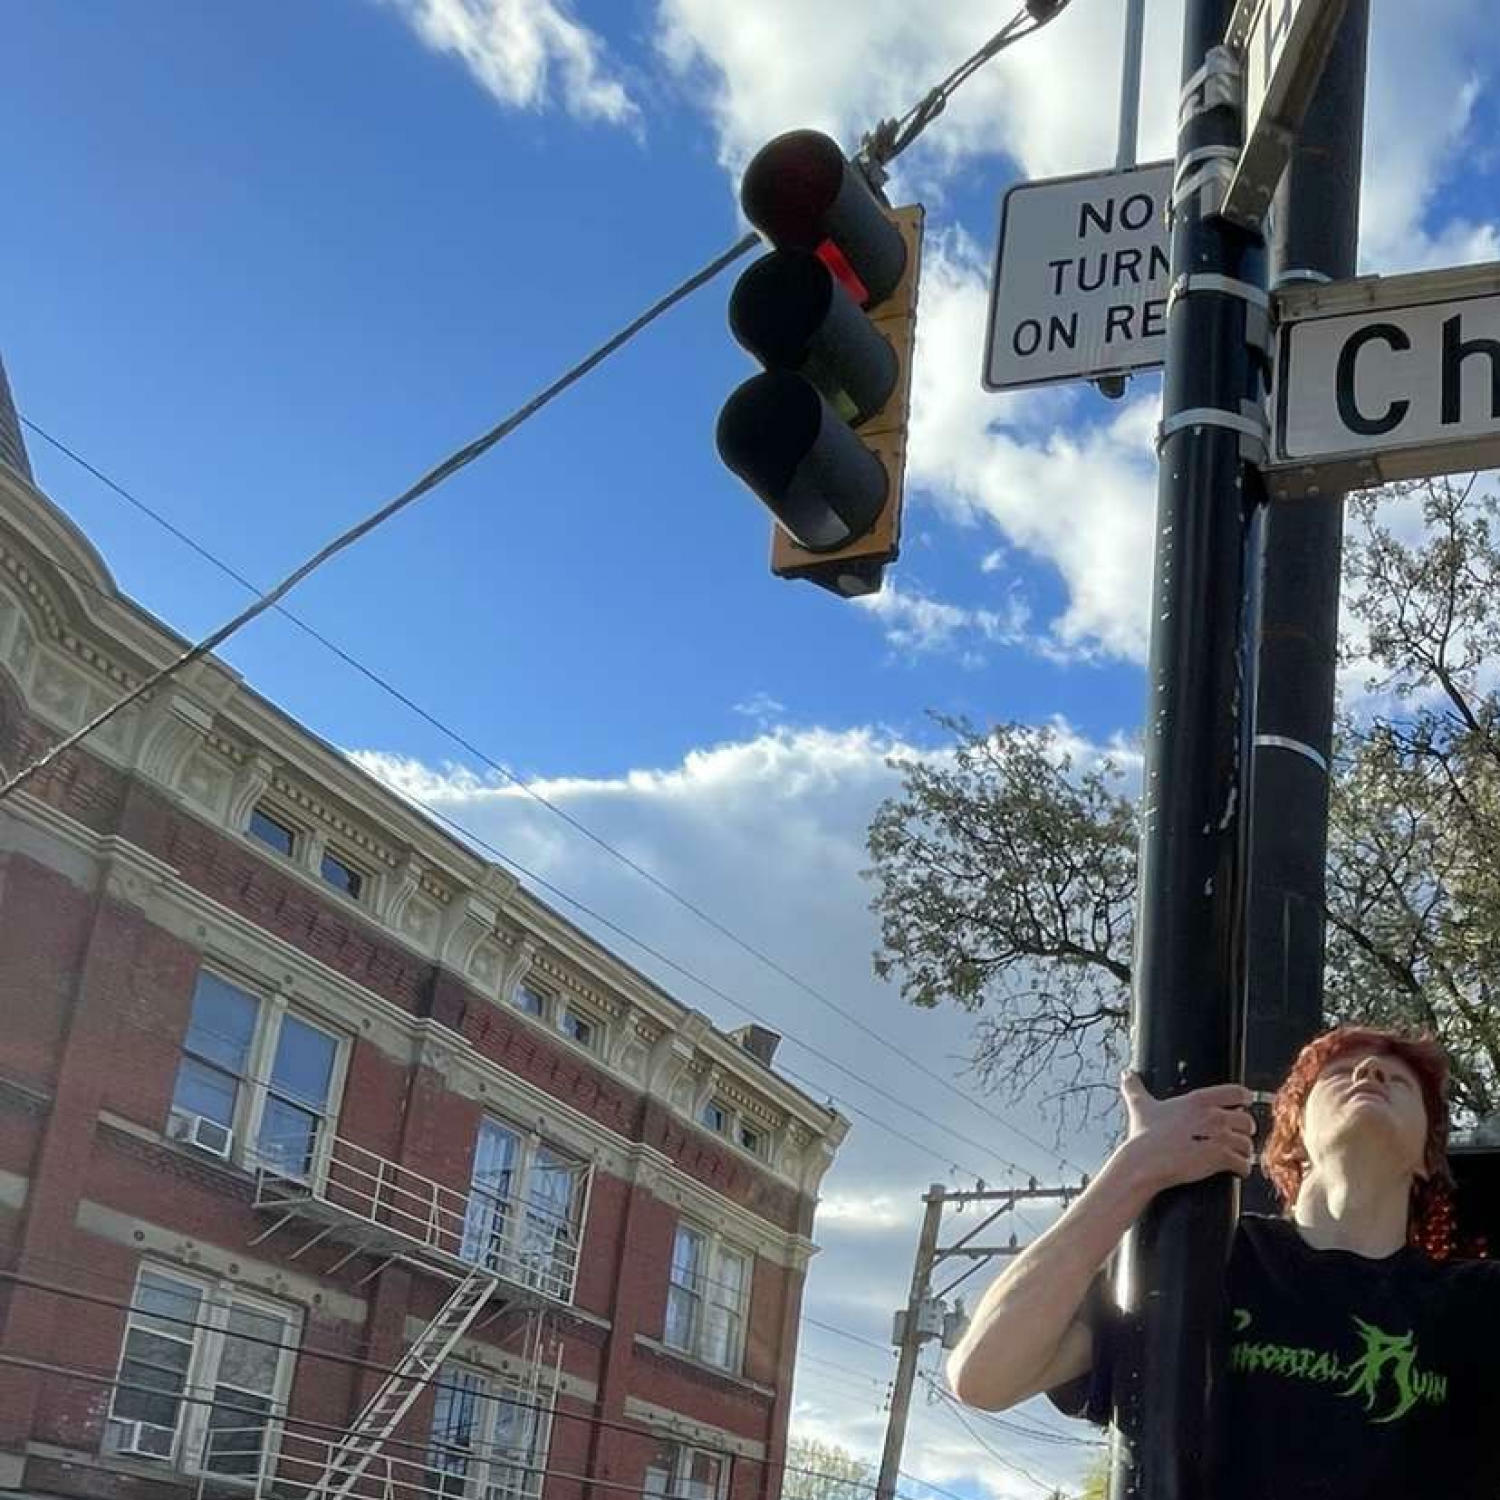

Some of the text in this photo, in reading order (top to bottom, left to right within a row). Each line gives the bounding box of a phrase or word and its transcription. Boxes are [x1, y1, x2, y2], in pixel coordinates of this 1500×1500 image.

[1078, 194, 1154, 238] NO
[1048, 245, 1170, 295] TURN
[1012, 297, 1168, 356] ON RE
